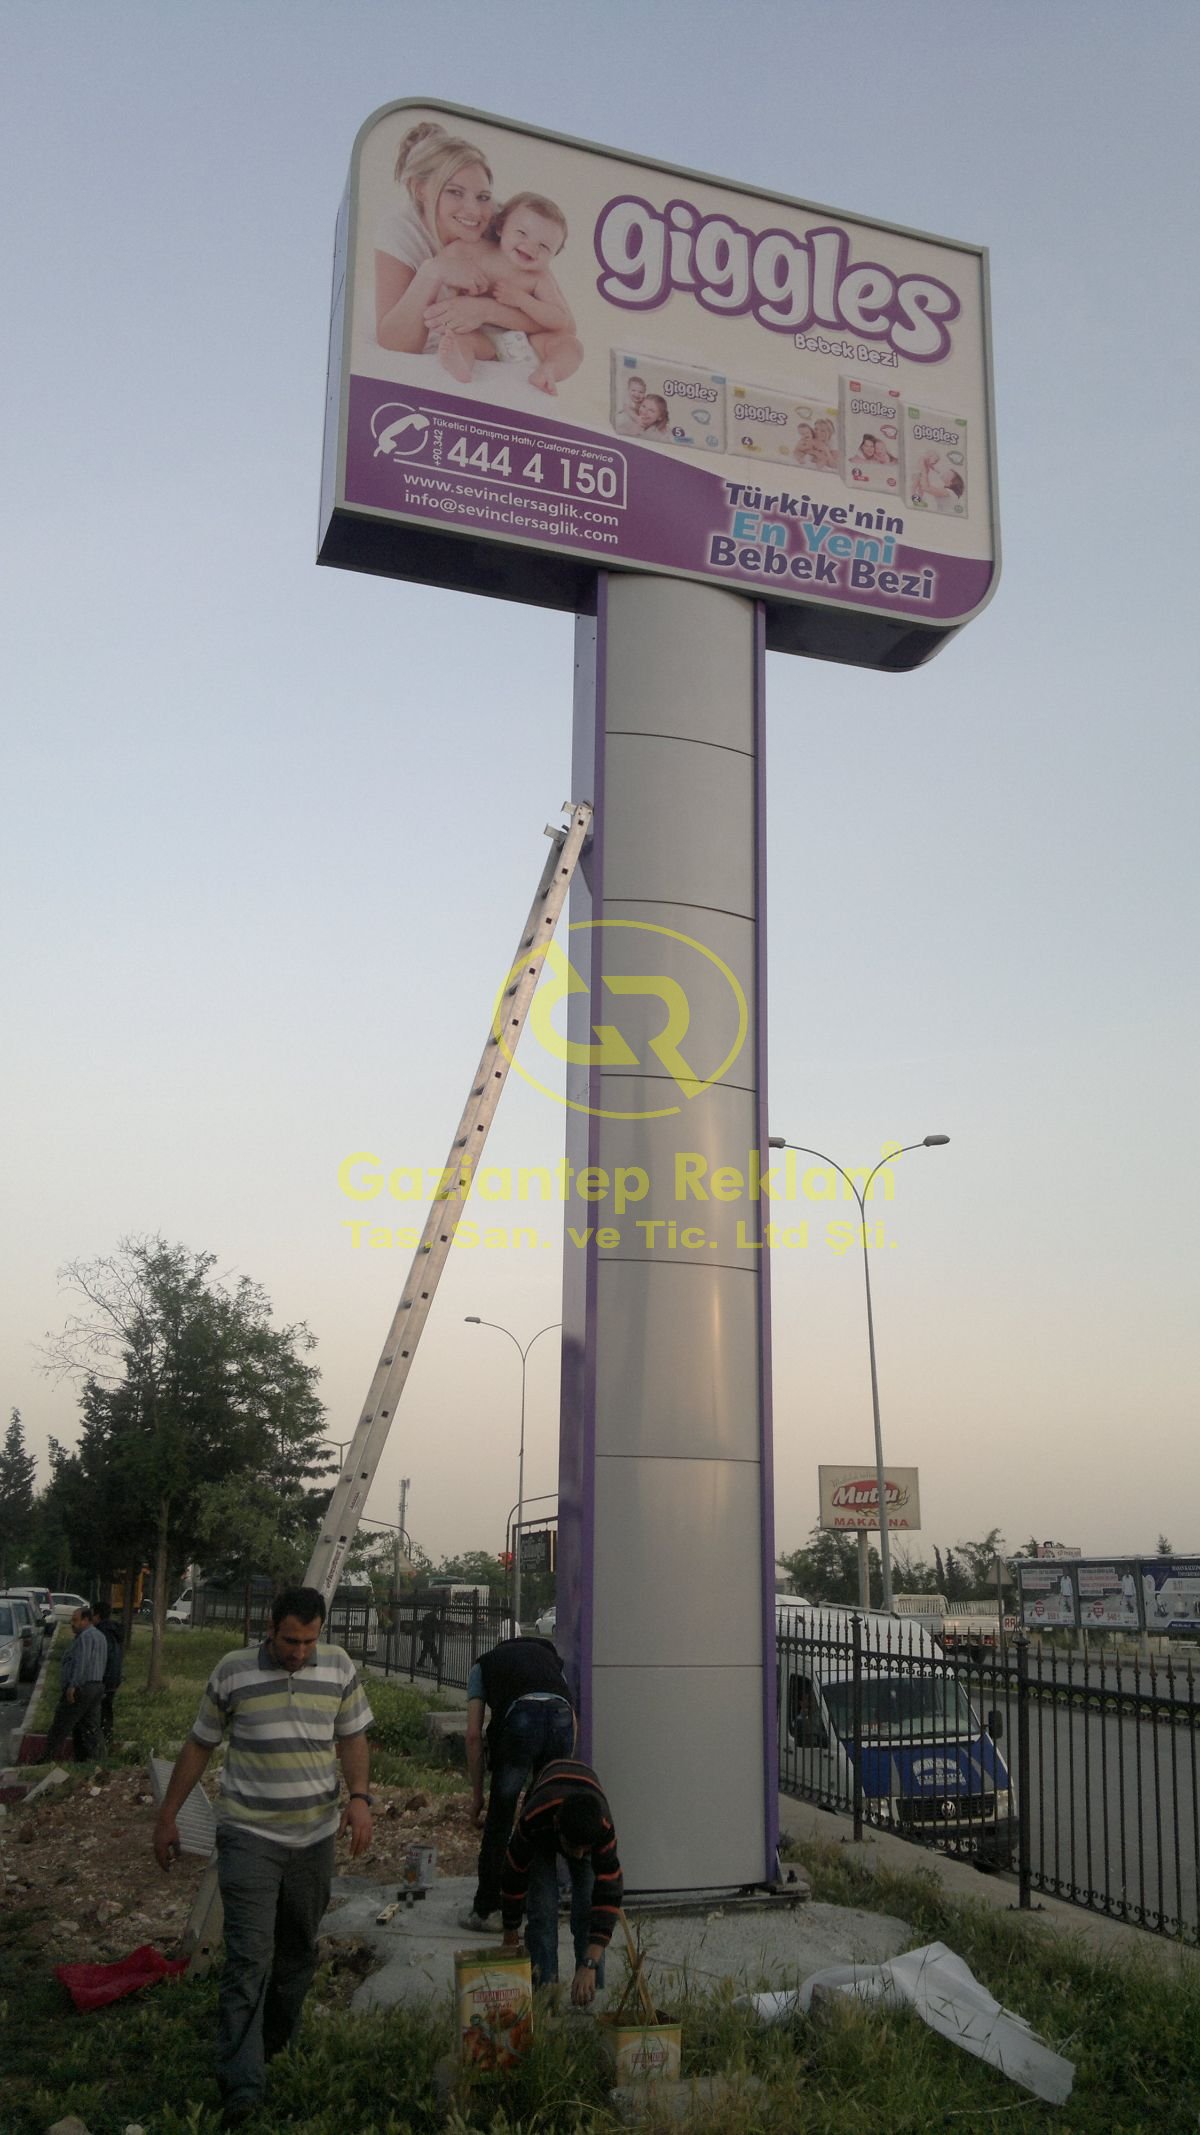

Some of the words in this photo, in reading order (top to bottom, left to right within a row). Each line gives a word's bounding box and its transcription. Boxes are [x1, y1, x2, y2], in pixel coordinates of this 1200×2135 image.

[594, 195, 960, 363] giggles
[794, 334, 854, 360] Bebek
[857, 345, 899, 368] Bezi
[663, 379, 718, 403] giggles
[734, 403, 788, 426] giggles
[851, 399, 896, 419] giggles
[432, 417, 468, 434] Tüketici
[537, 440, 580, 456] Customer
[581, 450, 614, 464] Service
[913, 425, 959, 445] giggles
[448, 437, 512, 476] 444
[523, 453, 544, 483] 4
[560, 458, 617, 498] 150
[404, 473, 619, 527] www.sevinclersaglik.com
[404, 489, 619, 545] info@sevinclersaglik.com
[725, 482, 905, 535] Türkiye'nin
[731, 510, 788, 548] En
[803, 522, 897, 565] Yeni
[709, 535, 838, 585] Bebek
[851, 558, 935, 600] Bezi
[832, 1484, 900, 1506] Mutu
[834, 1518, 909, 1527] MAKANA
